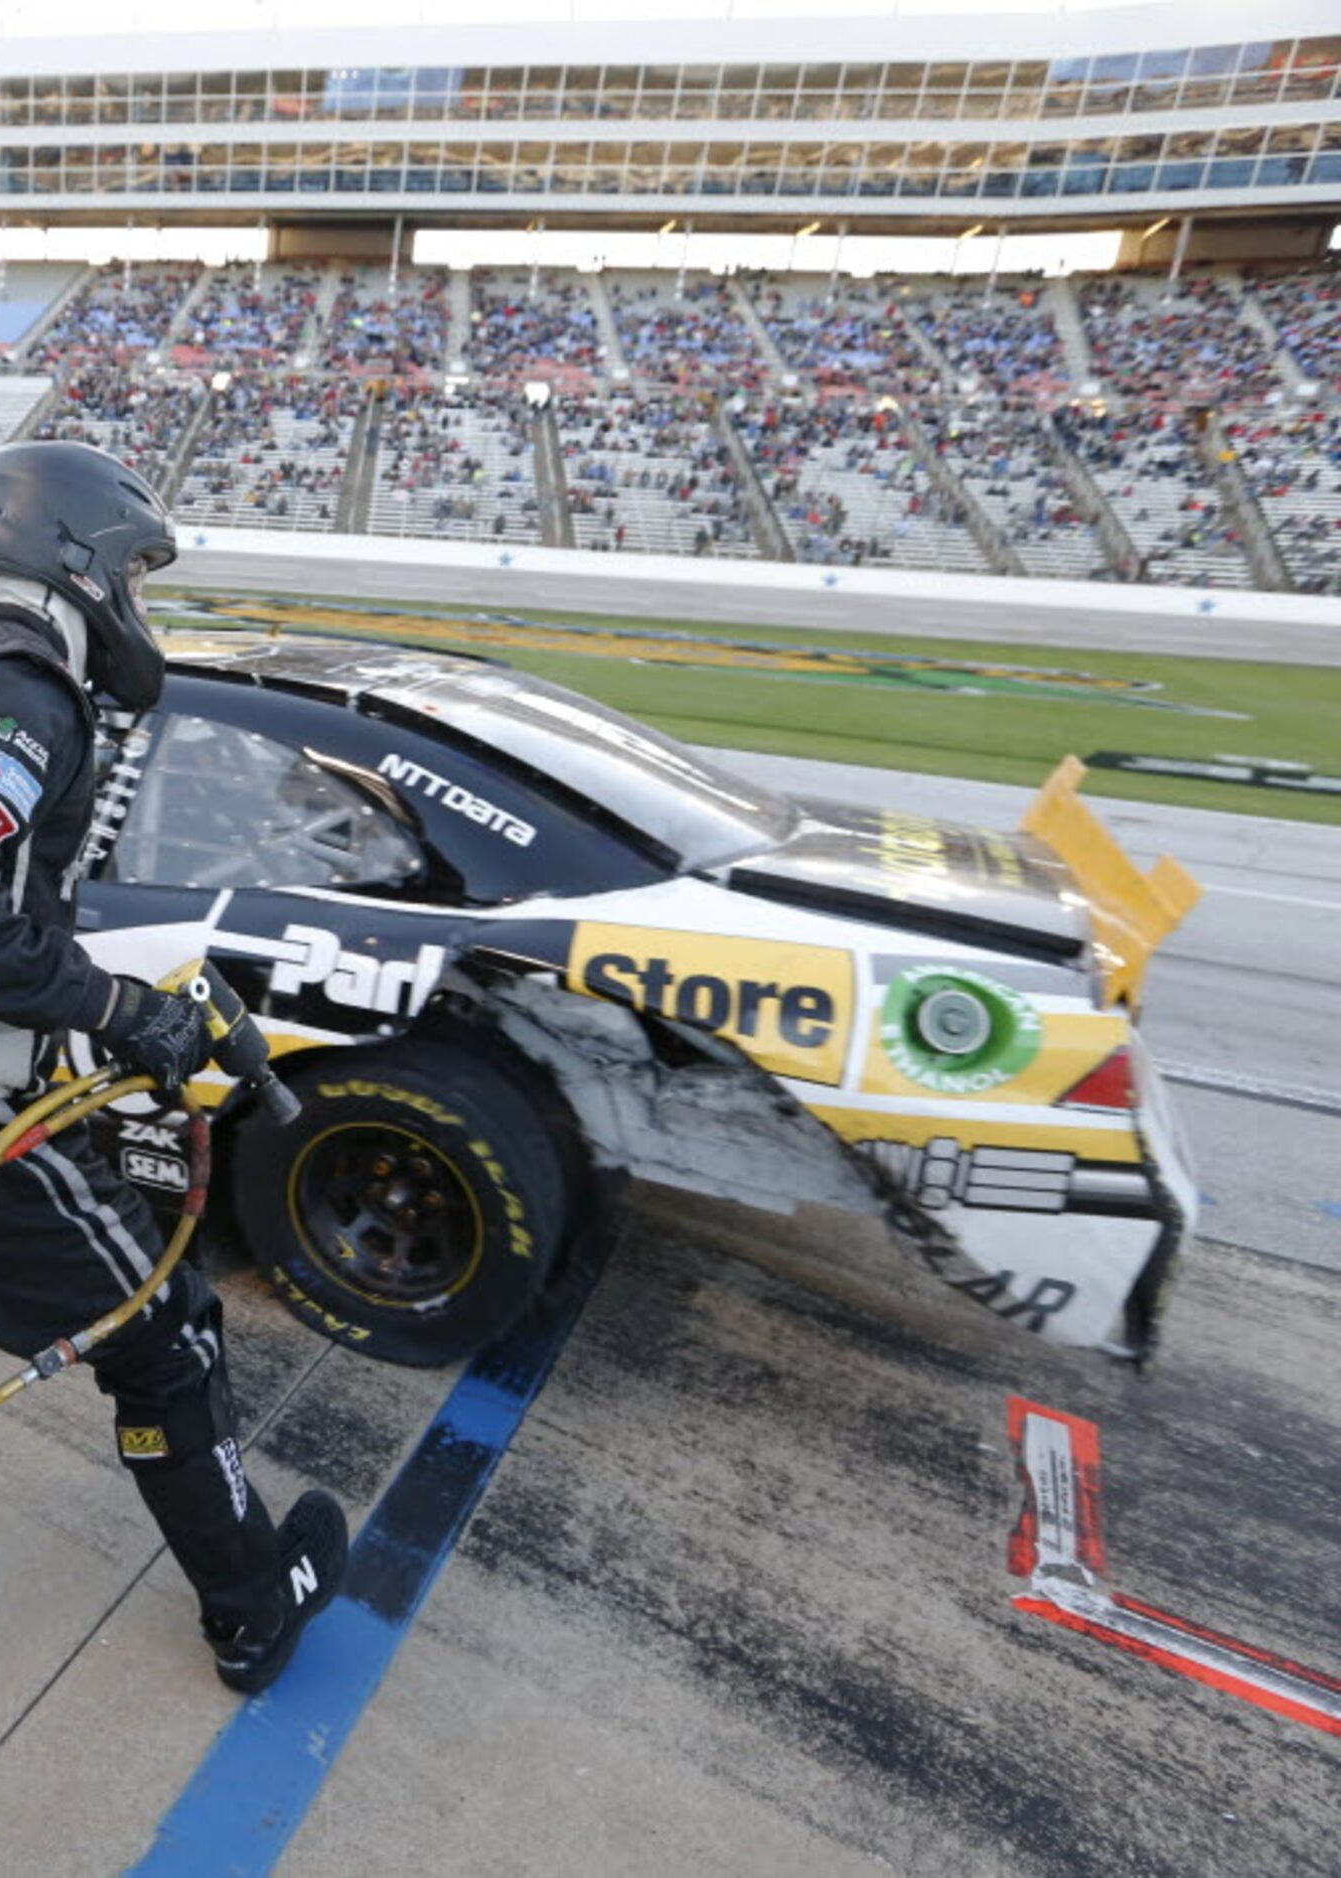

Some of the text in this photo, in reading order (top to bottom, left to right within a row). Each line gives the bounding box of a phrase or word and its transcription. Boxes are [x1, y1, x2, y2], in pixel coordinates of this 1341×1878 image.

[376, 753, 451, 797] NTT
[584, 953, 834, 1049] Store
[880, 1023, 1012, 1093] ETHANOL
[119, 1120, 182, 1152] ZAK
[127, 1154, 183, 1187] SEM
[290, 1555, 318, 1606] N
